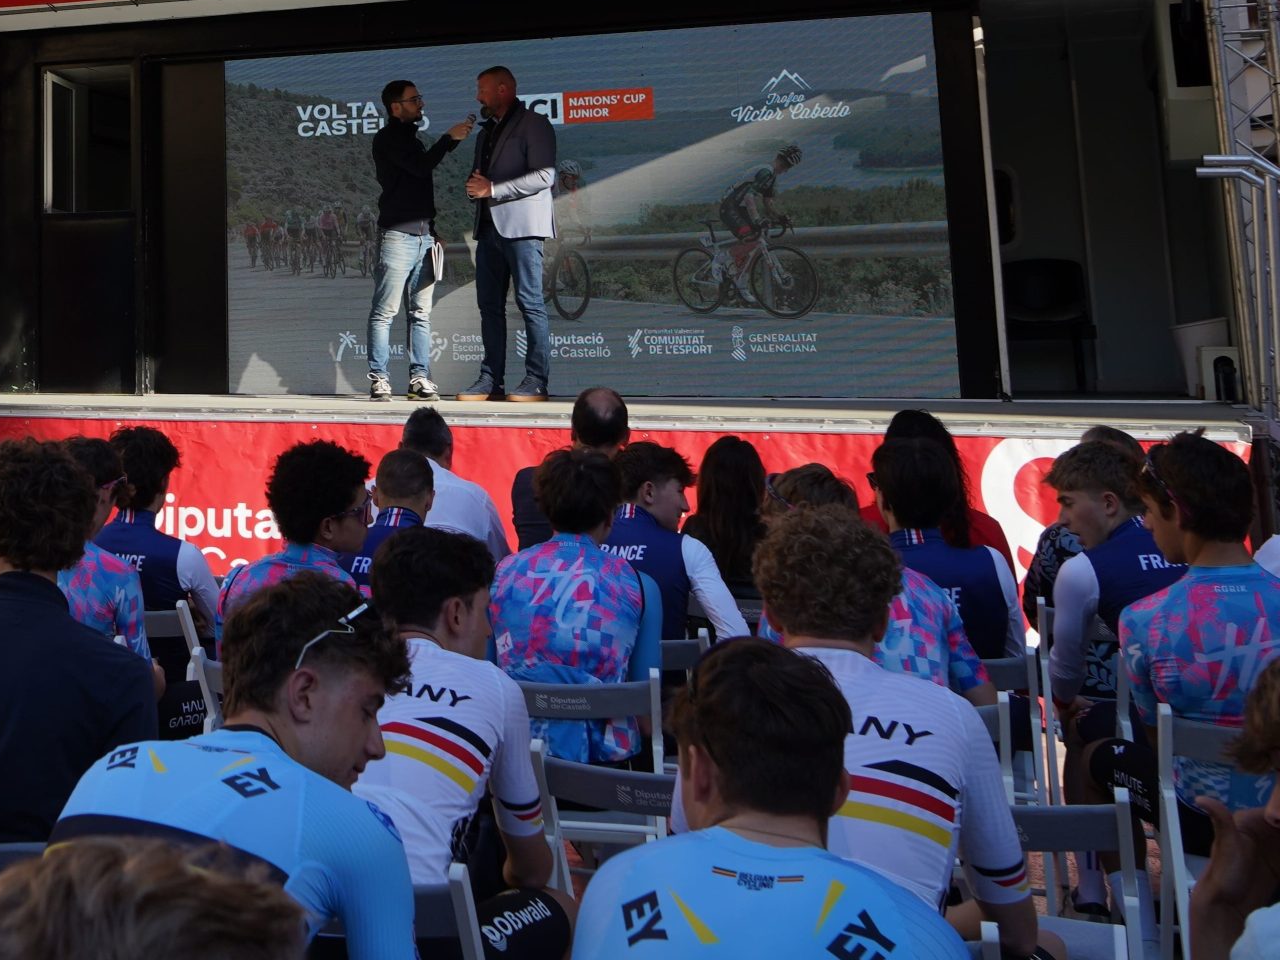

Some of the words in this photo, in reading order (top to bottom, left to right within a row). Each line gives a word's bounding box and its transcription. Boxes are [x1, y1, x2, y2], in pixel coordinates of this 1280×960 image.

[623, 93, 646, 105] CUP
[766, 92, 806, 107] Trofeo
[296, 101, 380, 122] VOLTA
[519, 98, 558, 120] CI
[568, 107, 609, 119] JUNIOR
[731, 105, 785, 123] Victor
[452, 333, 482, 343] Caste
[549, 332, 604, 349] iputació
[644, 335, 705, 345] COMUNITAT
[748, 333, 818, 343] GENERALITAT
[354, 344, 404, 355] TUME
[452, 344, 485, 352] Escena
[550, 349, 559, 358] e
[560, 347, 611, 358] Castelló
[649, 345, 663, 355] DE
[665, 344, 713, 355] L'ESPORT
[750, 344, 817, 353] VALENCIANA
[452, 352, 485, 362] Deport
[155, 493, 283, 540] iputa
[599, 544, 647, 561] RANCE
[550, 696, 587, 705] Diputació
[106, 746, 140, 771] EY
[222, 767, 282, 799] EY
[634, 789, 671, 800] Diputac
[622, 890, 668, 948] EY
